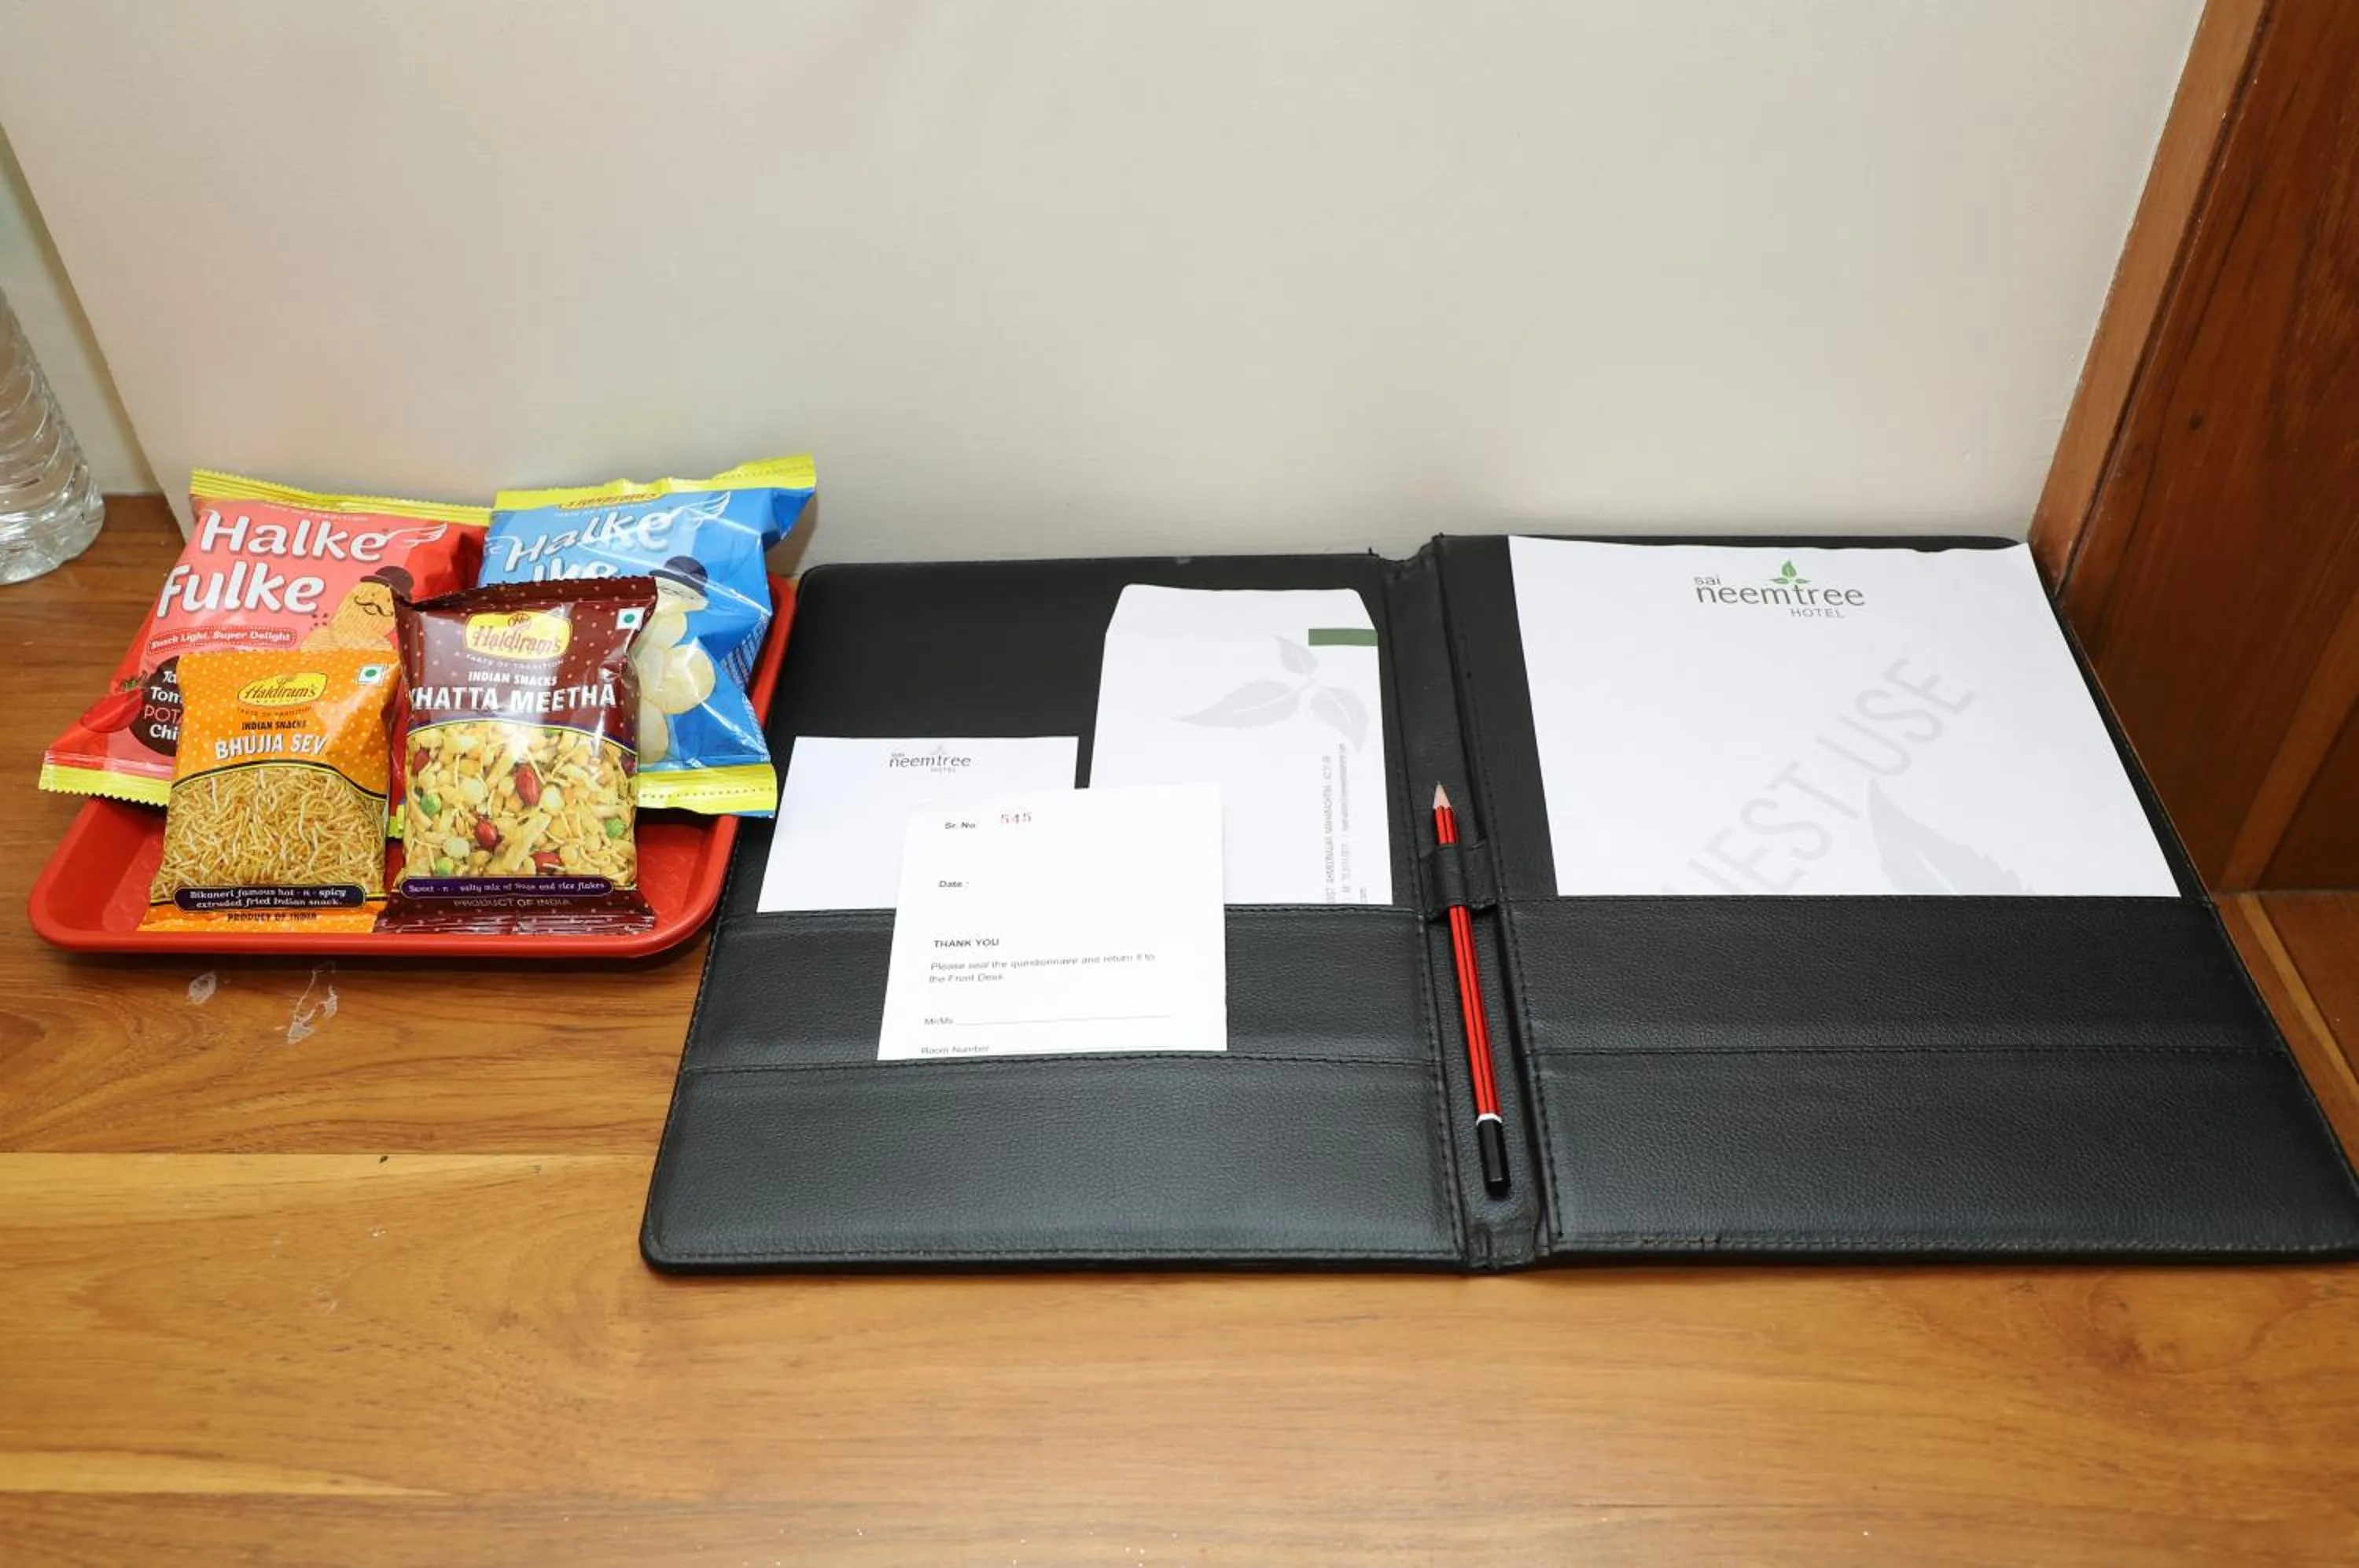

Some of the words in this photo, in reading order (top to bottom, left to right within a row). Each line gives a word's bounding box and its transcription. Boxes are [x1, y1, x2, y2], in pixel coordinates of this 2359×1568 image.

[201, 509, 389, 562] Halke
[505, 511, 675, 572] Halke
[1693, 575, 1721, 586] sai
[157, 560, 326, 618] Fulke
[1695, 584, 1866, 606] neemtree
[1790, 607, 1846, 619] HOTEL
[213, 631, 248, 642] Super
[250, 631, 291, 644] Delight
[472, 625, 562, 654] Haldiram's
[468, 671, 510, 684] INDIAN
[513, 673, 558, 686] SNACKS
[244, 683, 318, 700] Haldiram's
[510, 683, 616, 713] MEETHA
[1815, 657, 1976, 777] USE
[241, 720, 273, 731] INDIAN
[215, 732, 284, 760] BHUJIA
[290, 732, 328, 756] SEV
[889, 754, 972, 768] neemtree
[577, 881, 605, 892] flakes
[237, 888, 276, 900] famous
[278, 888, 294, 896] hot
[318, 888, 347, 898] spicy
[197, 900, 242, 909] extruded
[245, 898, 271, 908] fried
[273, 898, 307, 907] Indian
[517, 898, 533, 907] OF
[933, 938, 972, 948] THANK
[975, 937, 999, 948] YOU
[930, 962, 966, 971] Please
[992, 959, 1007, 969] the
[1081, 955, 1100, 965] and
[1102, 954, 1133, 963] return
[948, 973, 974, 982] Front
[921, 1046, 949, 1055] Room
[952, 1044, 990, 1053] Number
